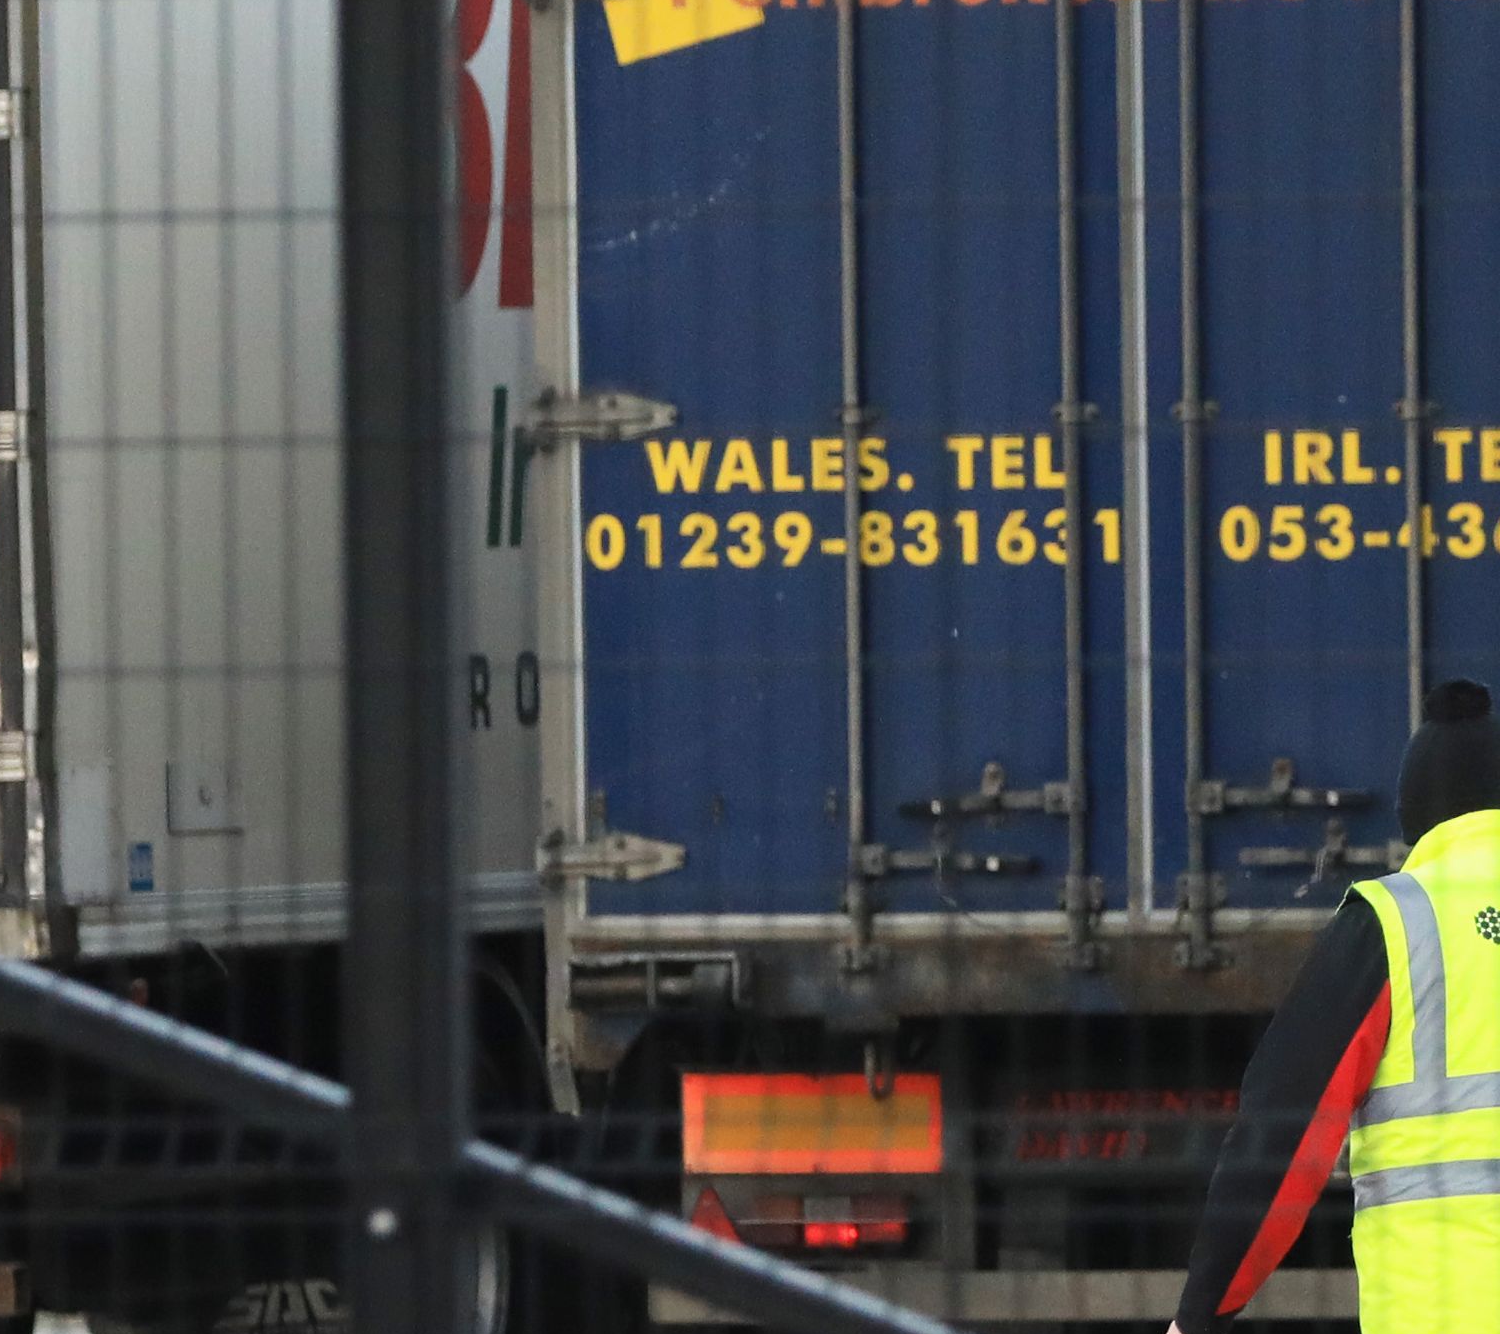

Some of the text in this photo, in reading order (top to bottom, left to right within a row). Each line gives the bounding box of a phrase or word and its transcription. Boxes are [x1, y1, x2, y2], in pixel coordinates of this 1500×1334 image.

[645, 437, 914, 494] WALES.
[1263, 430, 1402, 485] IRL.
[586, 508, 1123, 571] 01239-831631
